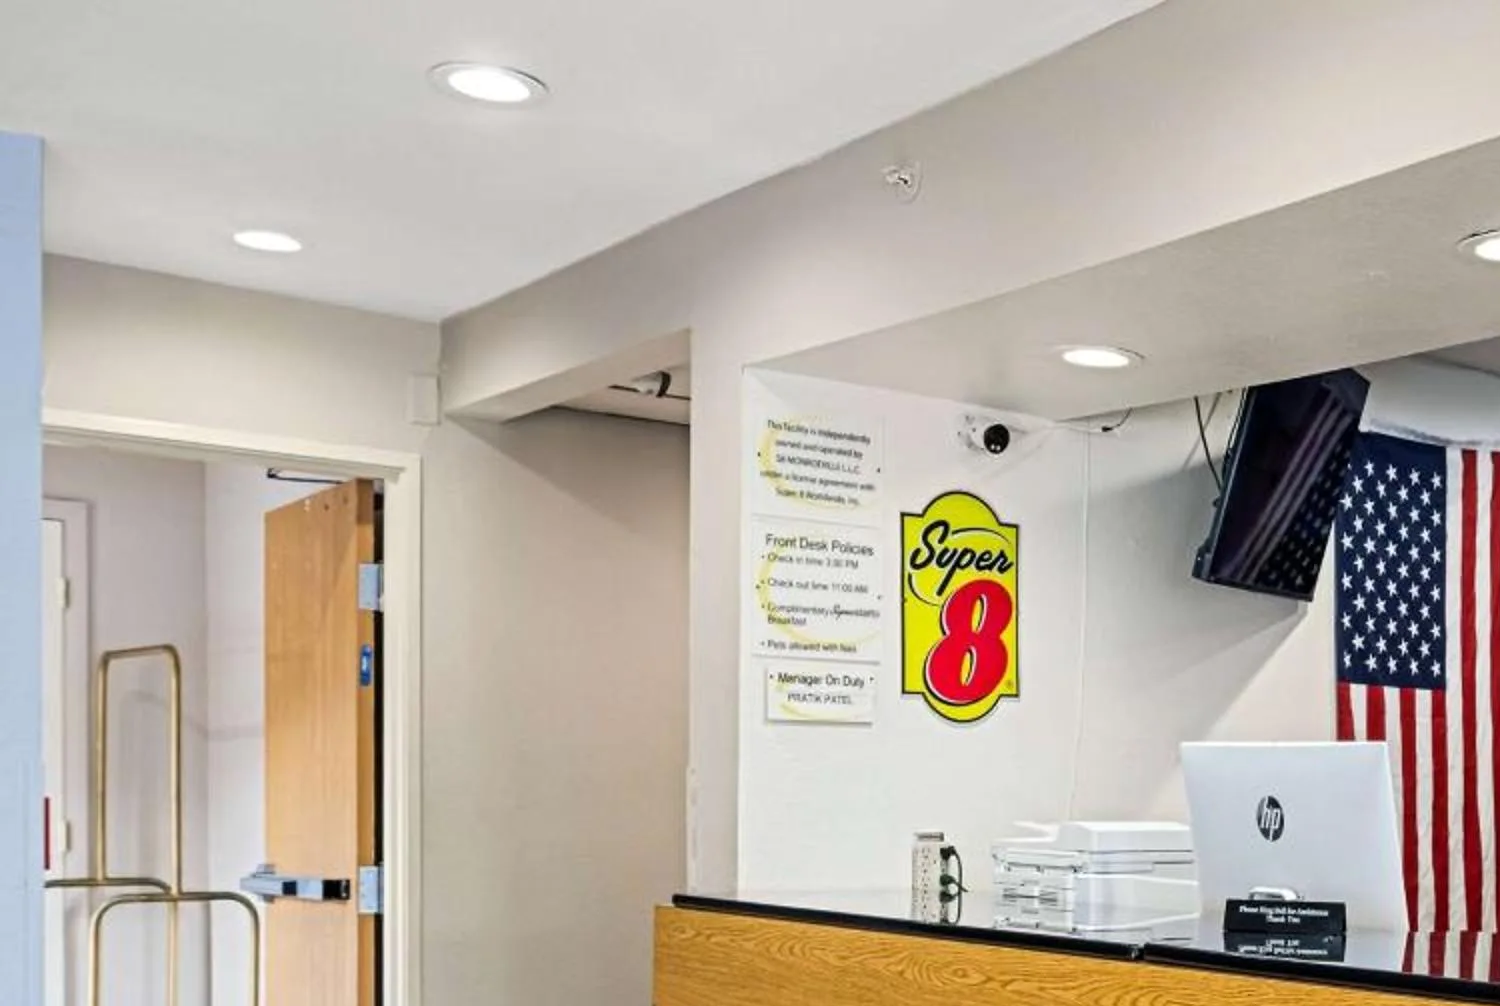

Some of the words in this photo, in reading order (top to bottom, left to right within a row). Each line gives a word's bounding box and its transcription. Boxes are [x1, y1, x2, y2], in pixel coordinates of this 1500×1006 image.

[766, 533, 797, 549] Front
[799, 536, 828, 551] Desk
[831, 539, 875, 556] Policies
[767, 552, 793, 564] Check
[909, 519, 1014, 597] Super
[767, 577, 793, 587] Check
[923, 579, 1014, 707] 8
[778, 672, 822, 687] Manager
[825, 673, 841, 686] On
[843, 675, 865, 689] Duty
[1258, 796, 1284, 842] hp
